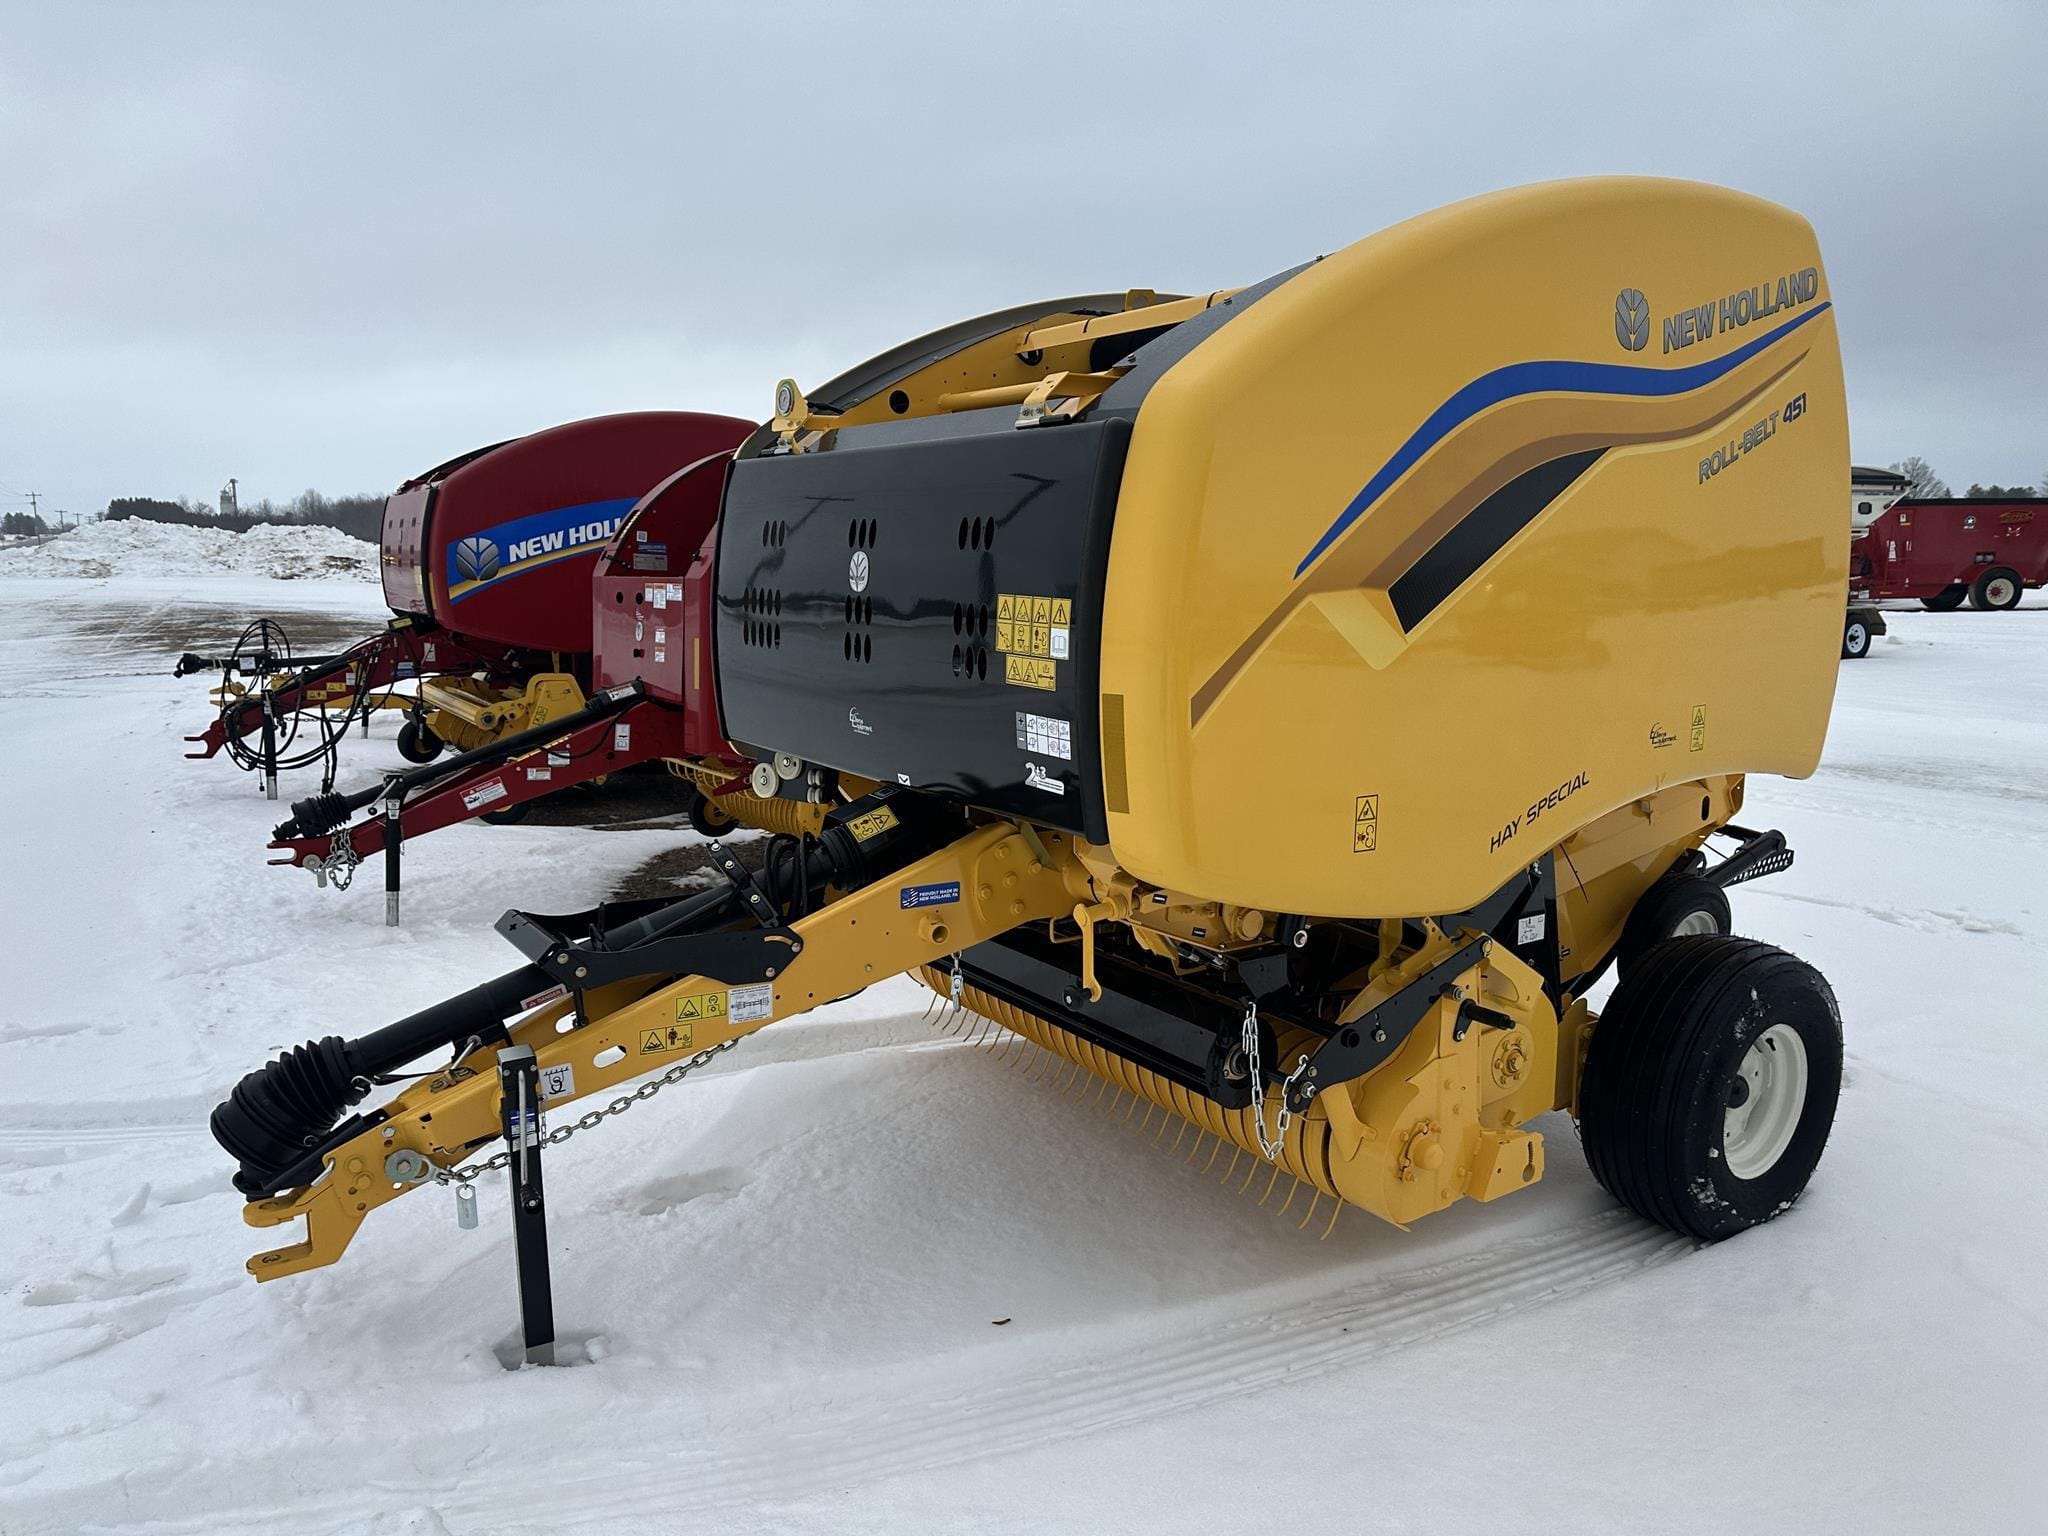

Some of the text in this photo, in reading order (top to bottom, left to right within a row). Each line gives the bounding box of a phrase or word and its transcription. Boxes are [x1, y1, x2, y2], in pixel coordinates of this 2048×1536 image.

[1662, 266, 1819, 355] NEW HOLLAND
[1698, 391, 1808, 486] ROLL-BELT 451
[508, 529, 565, 564] NEW
[1489, 770, 1590, 854] HAY SPECIAL
